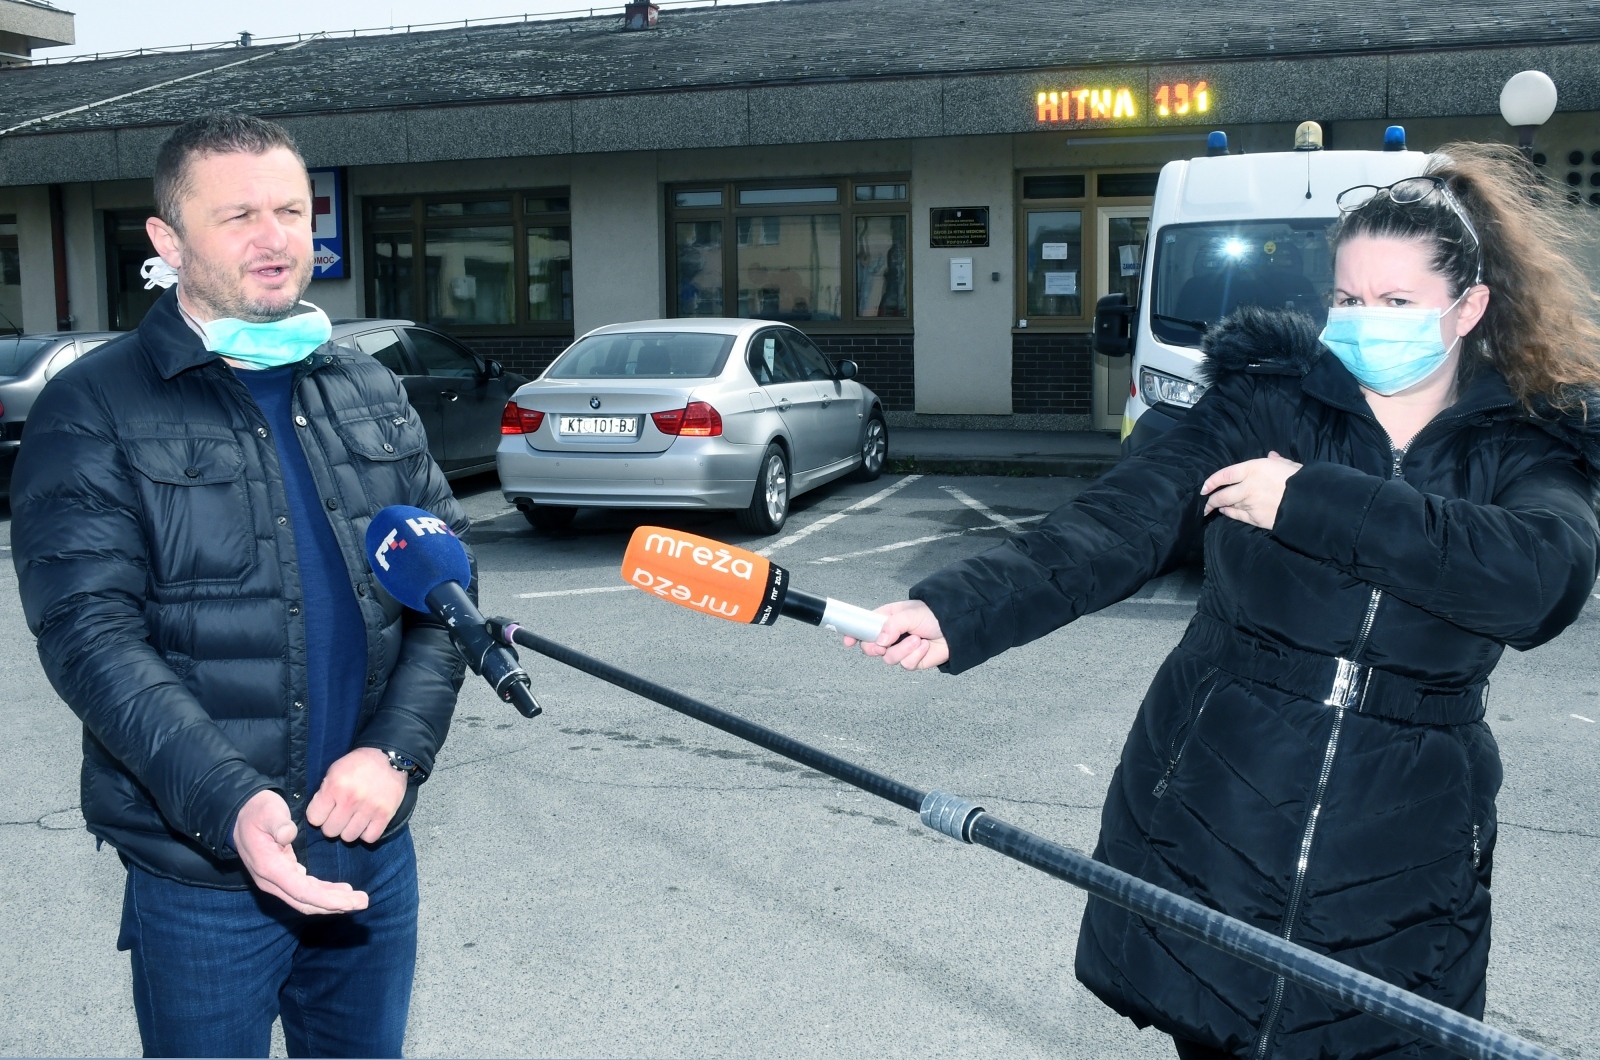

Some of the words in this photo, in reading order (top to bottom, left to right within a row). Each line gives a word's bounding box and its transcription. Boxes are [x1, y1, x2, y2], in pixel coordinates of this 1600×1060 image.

[1038, 88, 1135, 121] HITNA
[567, 418, 584, 433] KT
[594, 419, 635, 433] 101-BJ
[644, 533, 754, 580] mreža
[631, 567, 740, 617] mreža
